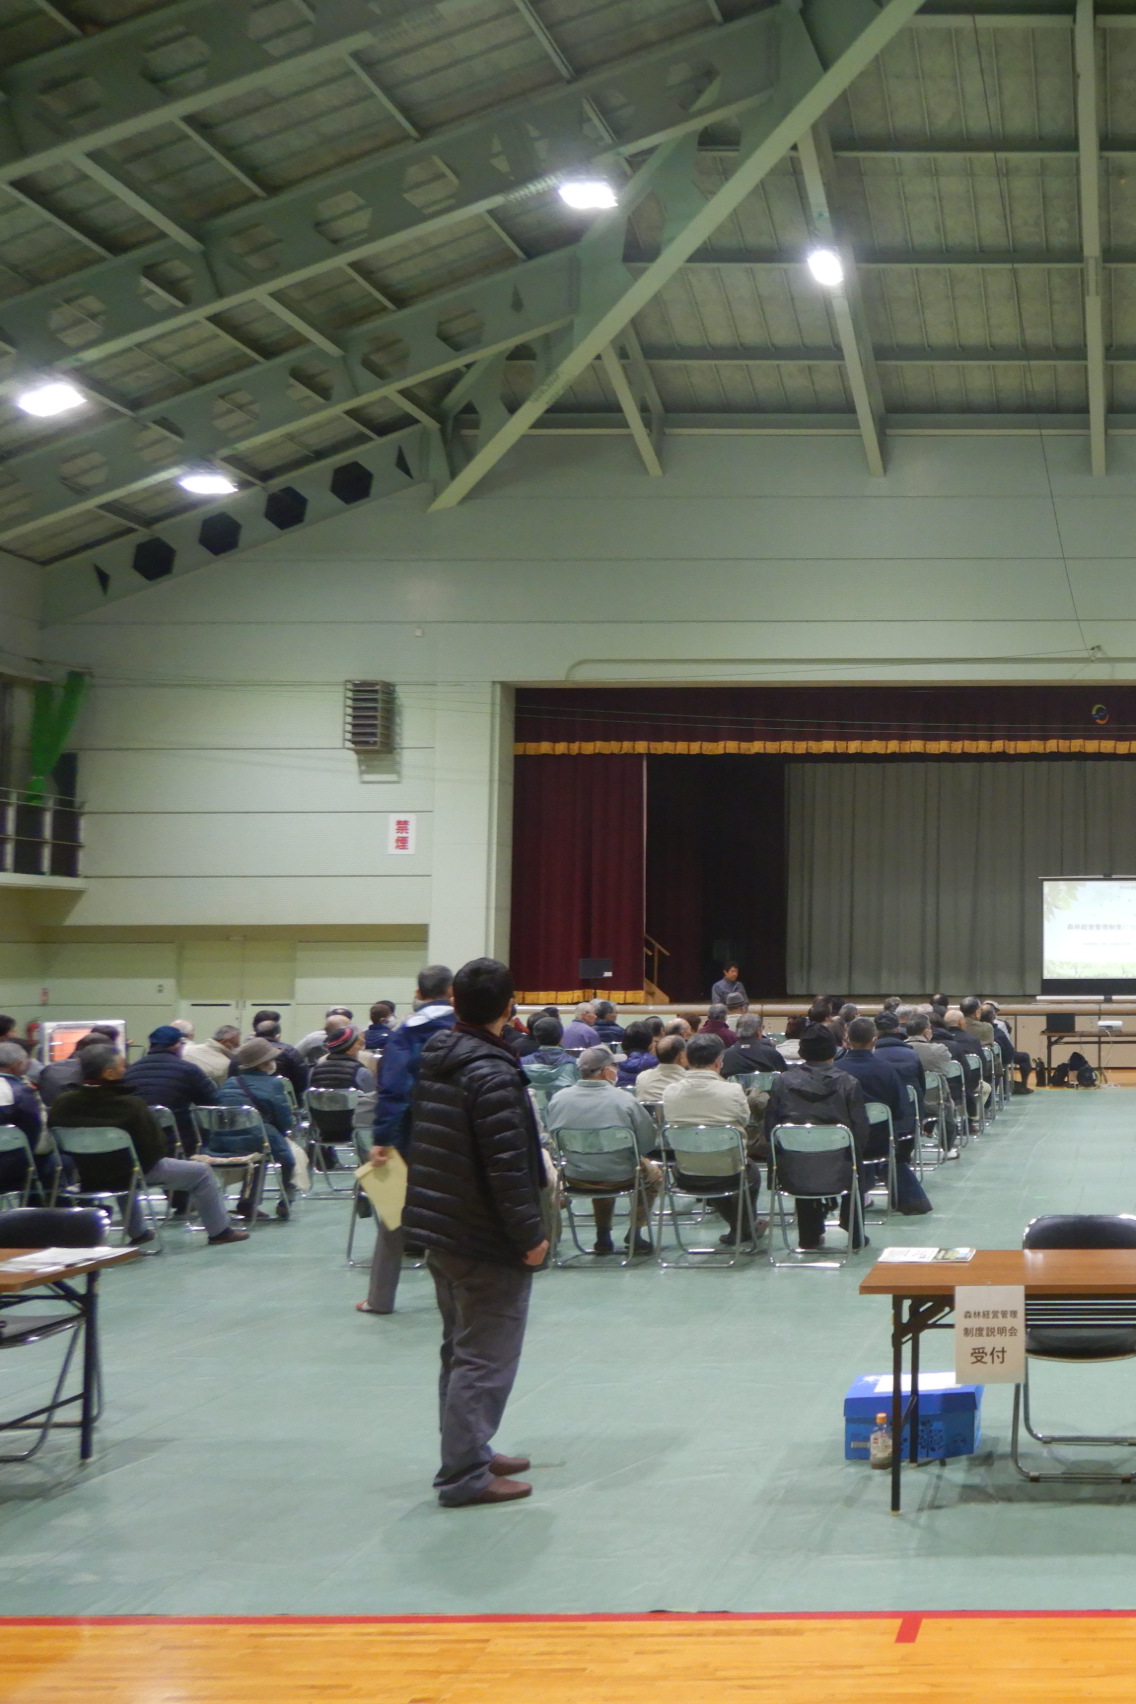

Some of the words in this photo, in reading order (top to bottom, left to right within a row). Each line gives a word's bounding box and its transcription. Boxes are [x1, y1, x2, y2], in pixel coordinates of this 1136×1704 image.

[963, 1310, 1018, 1319] 森林経営管理
[963, 1326, 1019, 1338] 制度説明会
[970, 1346, 1008, 1365] 受付
